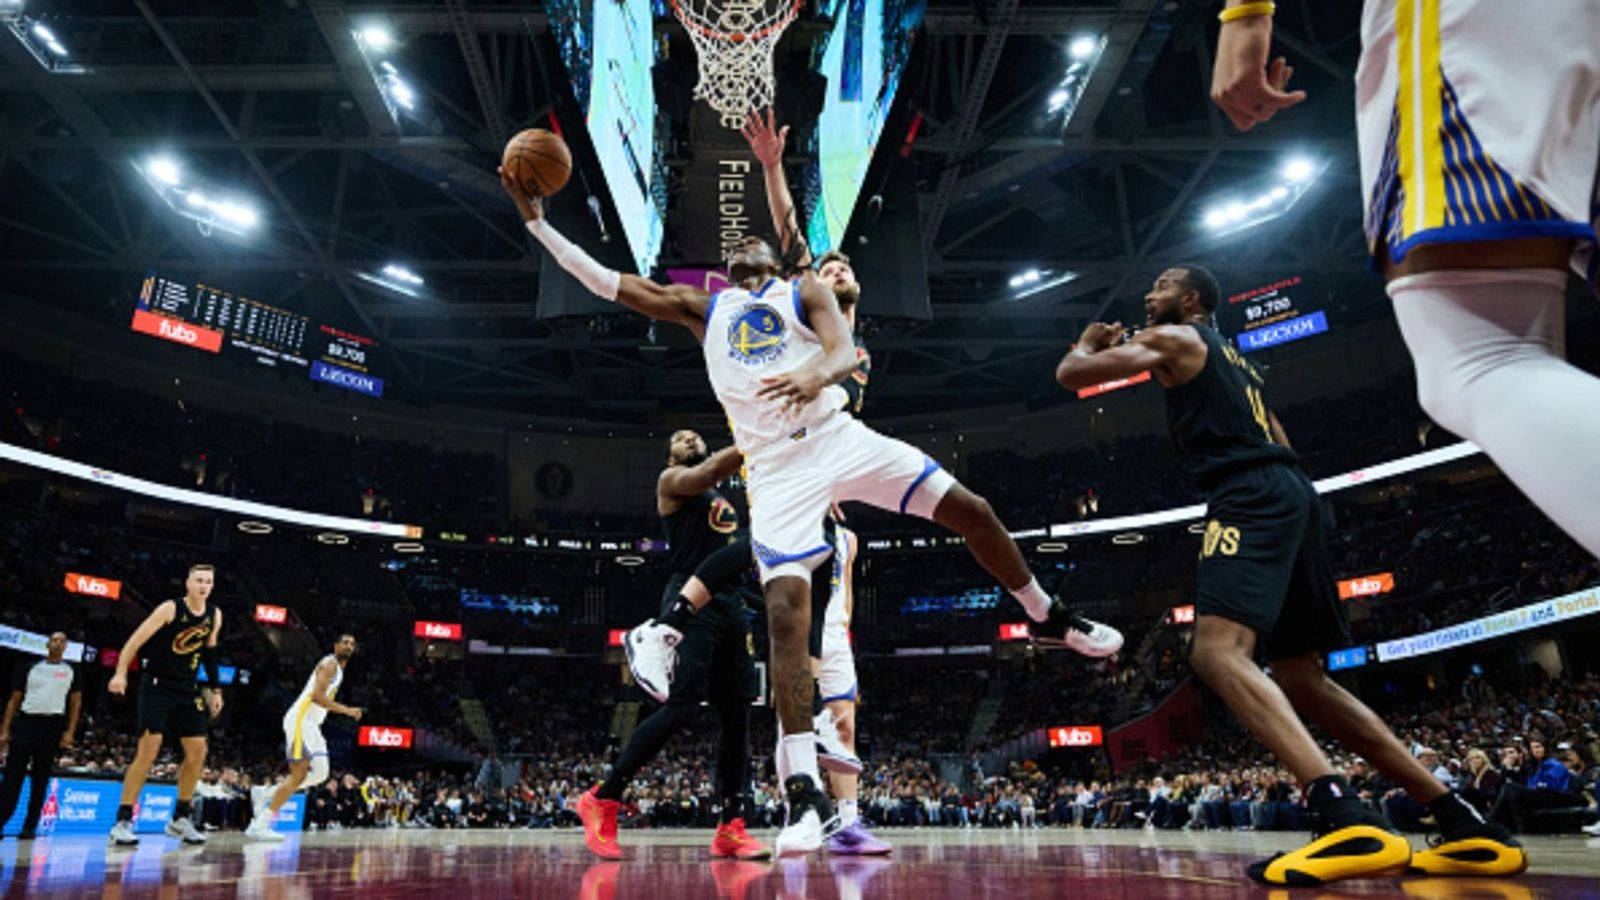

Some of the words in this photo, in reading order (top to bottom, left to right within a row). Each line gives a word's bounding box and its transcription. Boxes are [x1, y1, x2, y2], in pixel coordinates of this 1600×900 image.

[159, 318, 197, 343] fubo
[78, 577, 109, 596] fubo
[1351, 578, 1382, 597] fubo
[1531, 603, 1555, 622] and
[425, 623, 452, 638] fubo
[369, 727, 403, 746] fubo
[1057, 728, 1093, 745] fubo
